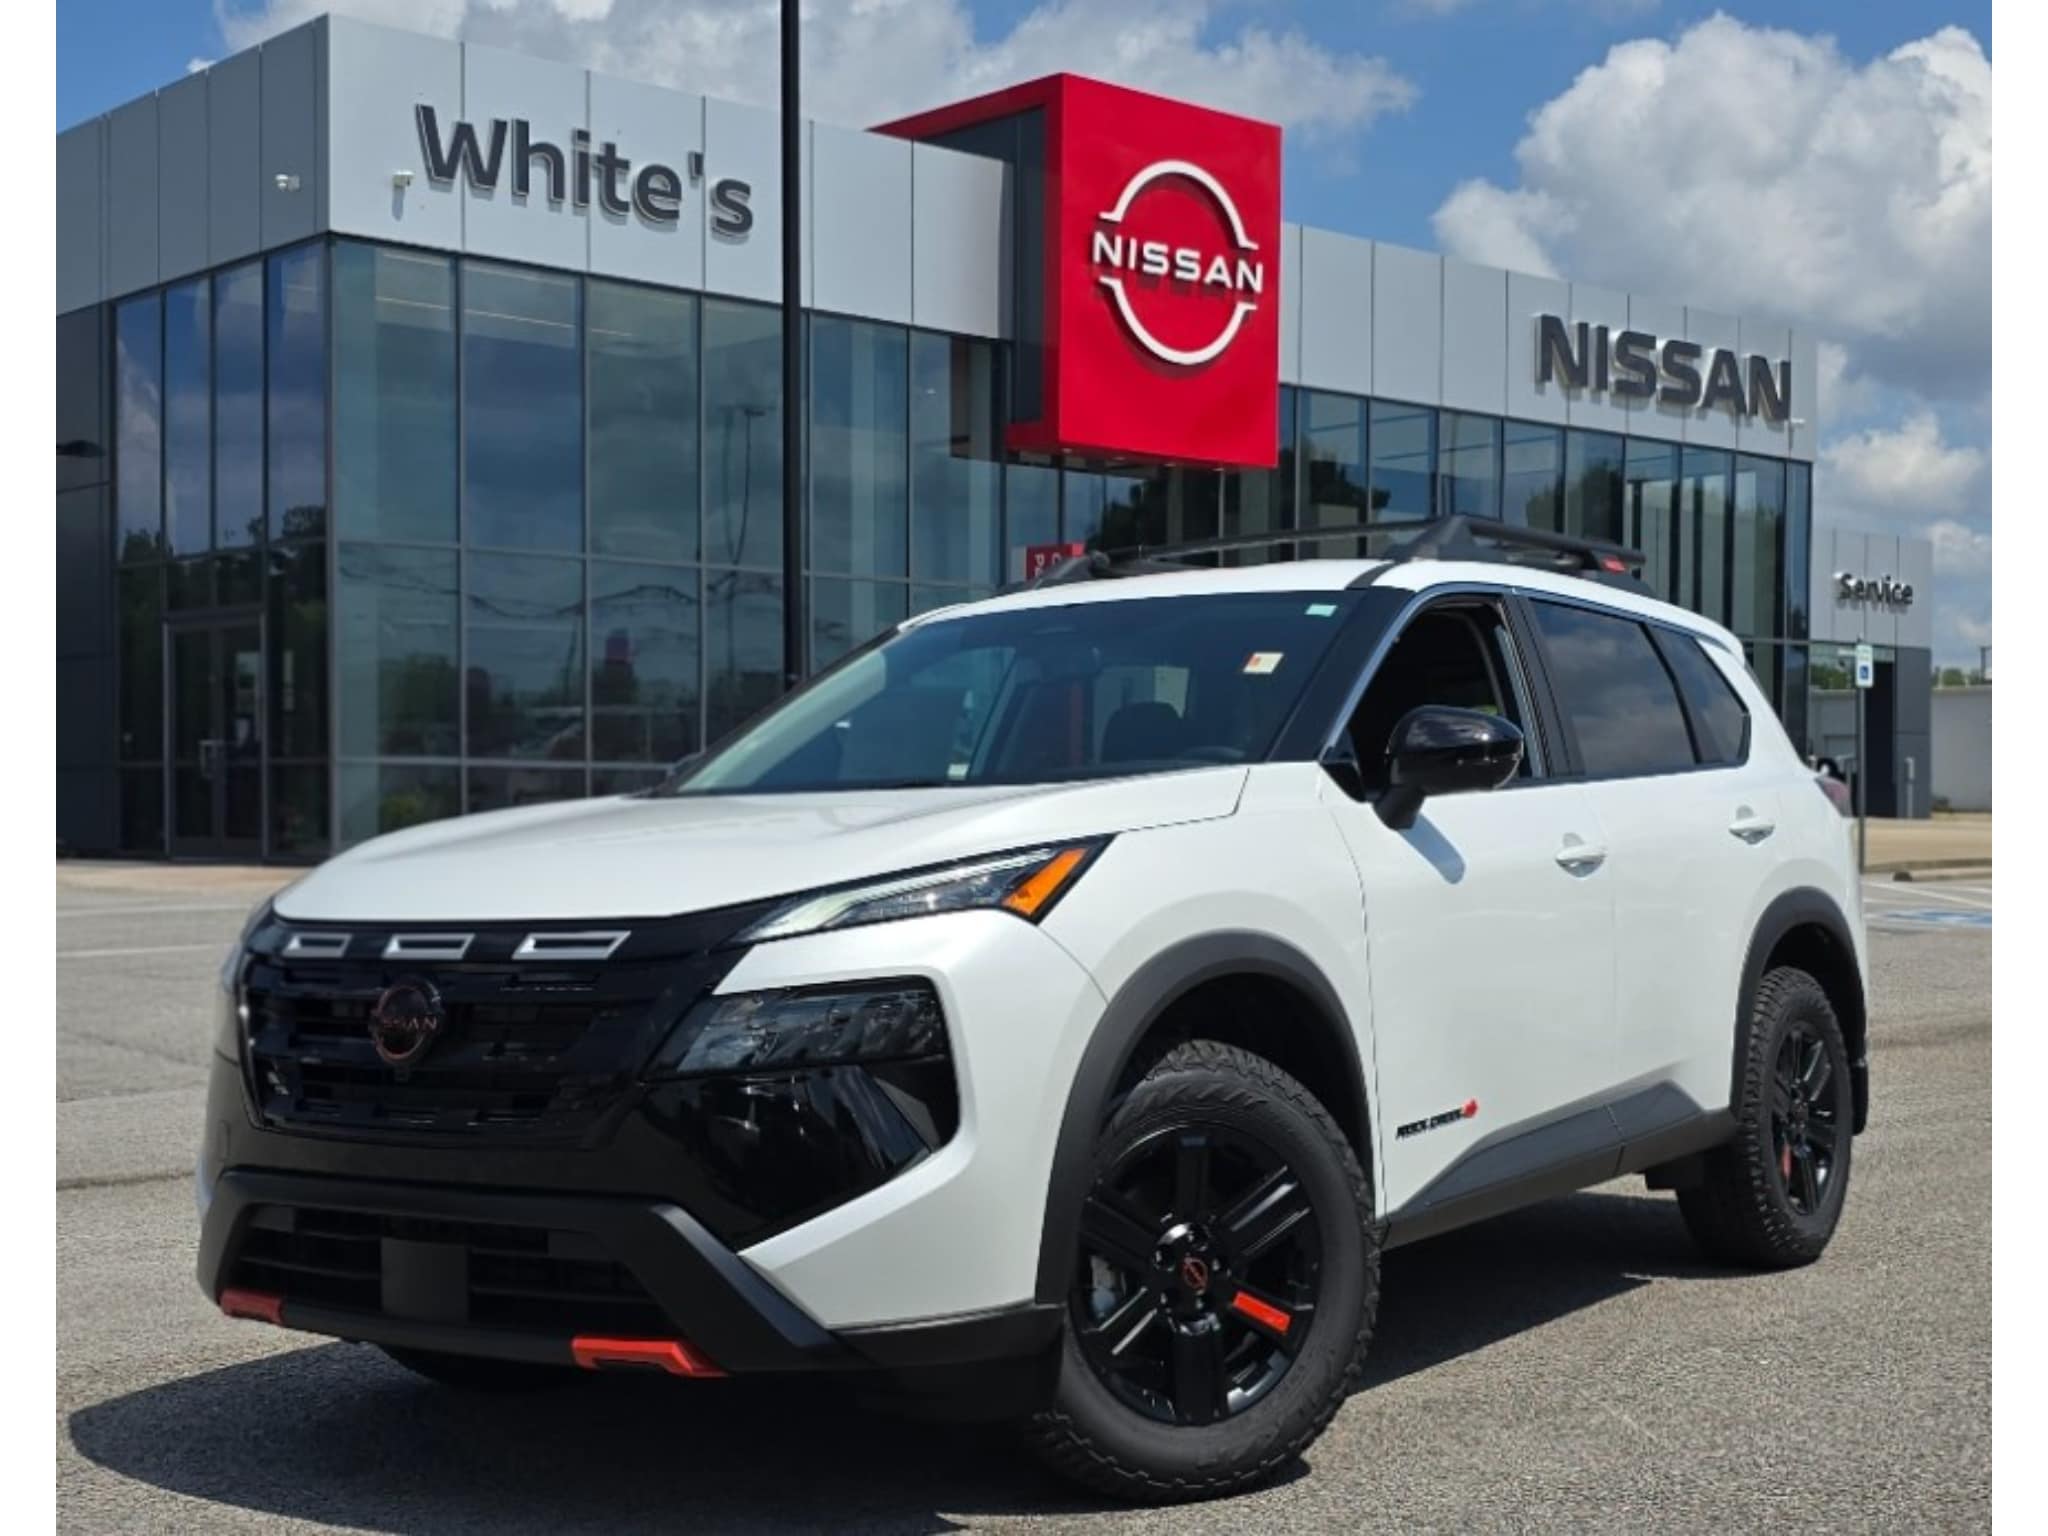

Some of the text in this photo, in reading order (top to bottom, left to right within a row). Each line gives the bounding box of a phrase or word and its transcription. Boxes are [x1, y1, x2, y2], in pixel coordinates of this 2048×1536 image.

[415, 102, 755, 236] White's
[1092, 230, 1264, 294] NISSAN
[1535, 313, 1792, 422] NISSAN
[1836, 572, 1914, 607] Service
